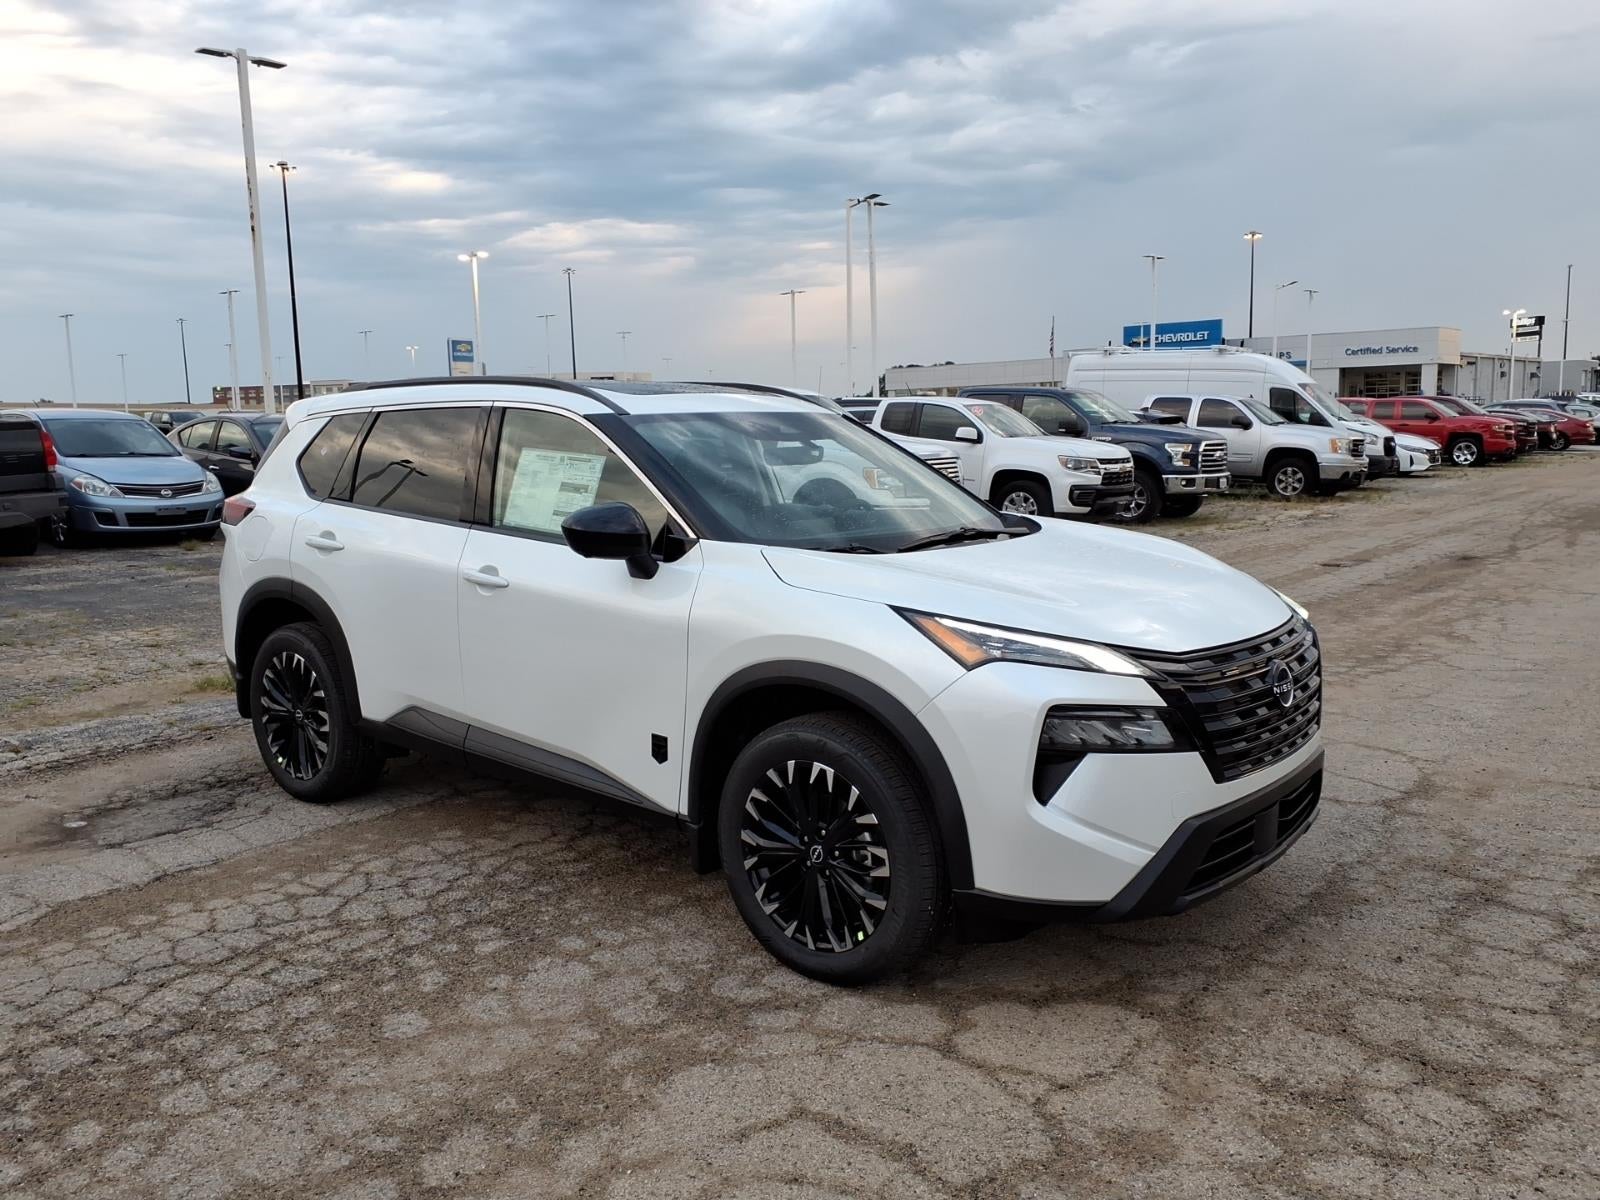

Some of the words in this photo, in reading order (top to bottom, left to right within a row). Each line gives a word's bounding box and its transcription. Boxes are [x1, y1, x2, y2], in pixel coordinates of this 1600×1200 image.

[1154, 330, 1210, 344] CHEVROLET
[1345, 346, 1383, 356] Certified
[1385, 345, 1419, 354] Service
